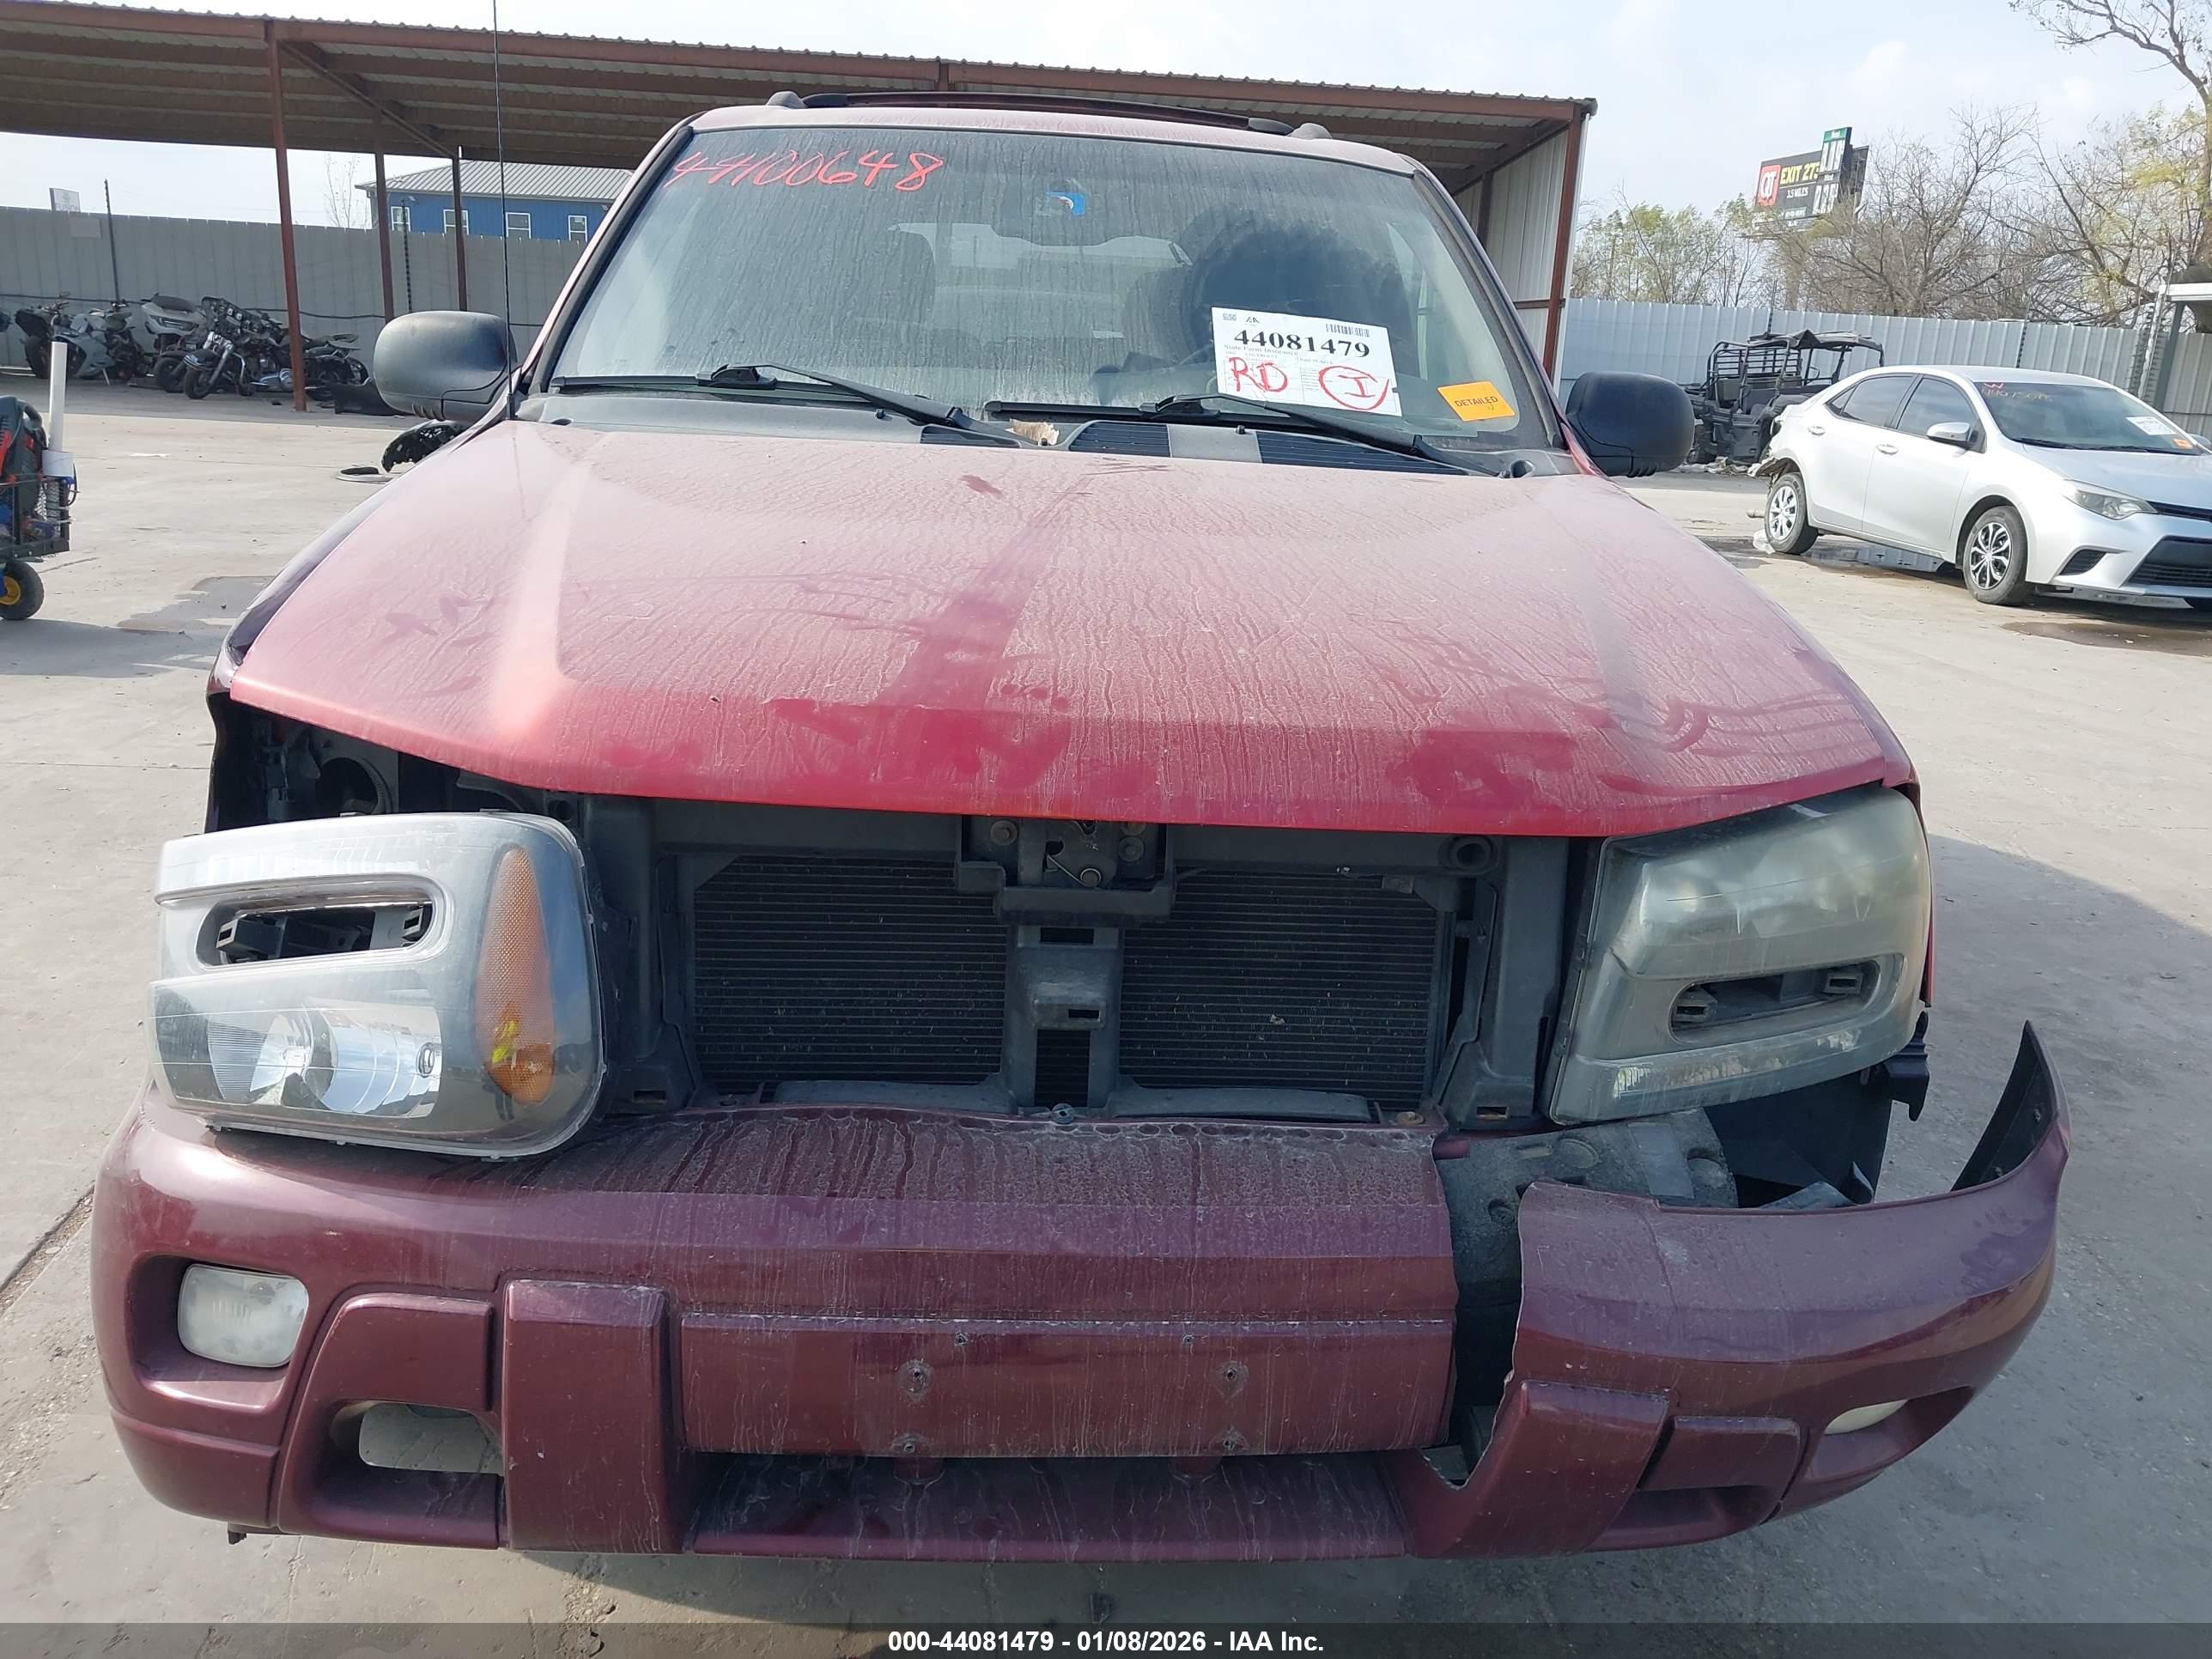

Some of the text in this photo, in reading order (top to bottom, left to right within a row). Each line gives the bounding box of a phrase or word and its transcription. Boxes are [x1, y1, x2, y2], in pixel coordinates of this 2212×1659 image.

[1760, 172, 1778, 198] QT
[1780, 166, 1802, 184] EXIT
[1234, 329, 1370, 357] 44081479
[1455, 396, 1498, 407] DETAILED
